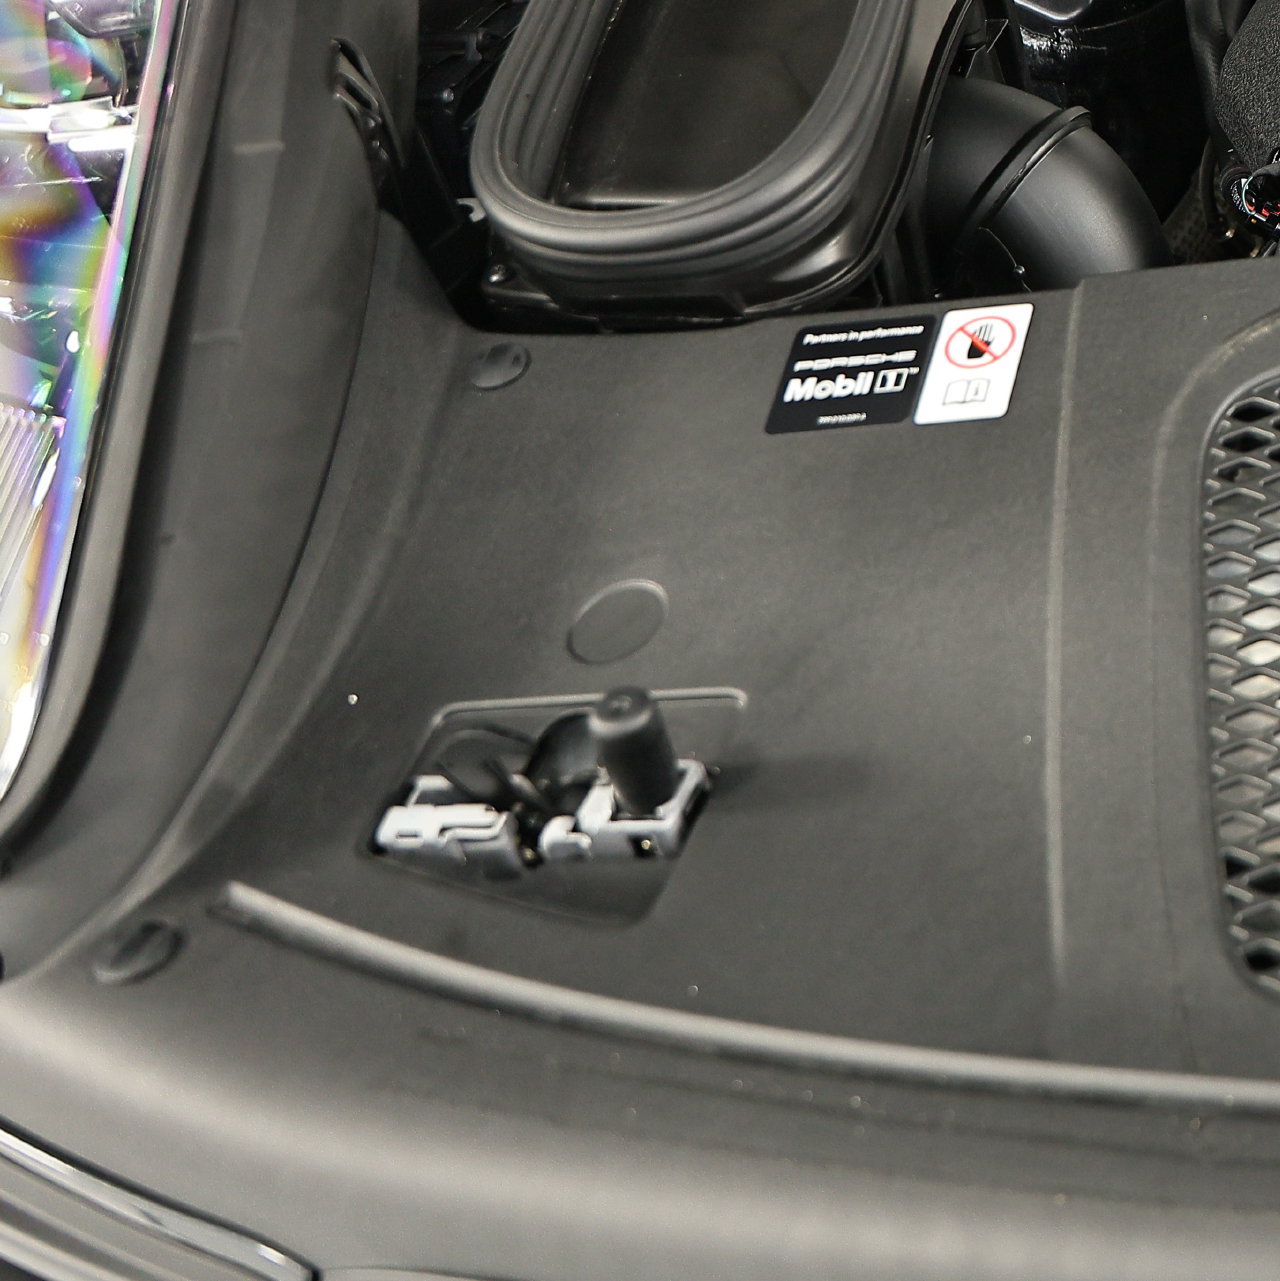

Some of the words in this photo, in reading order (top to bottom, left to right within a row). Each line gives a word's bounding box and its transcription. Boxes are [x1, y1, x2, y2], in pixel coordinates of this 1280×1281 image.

[803, 333, 848, 345] Partners
[848, 330, 859, 341] in
[858, 325, 924, 342] performance
[793, 350, 917, 372] PORSCHE
[783, 371, 875, 403] Mobil
